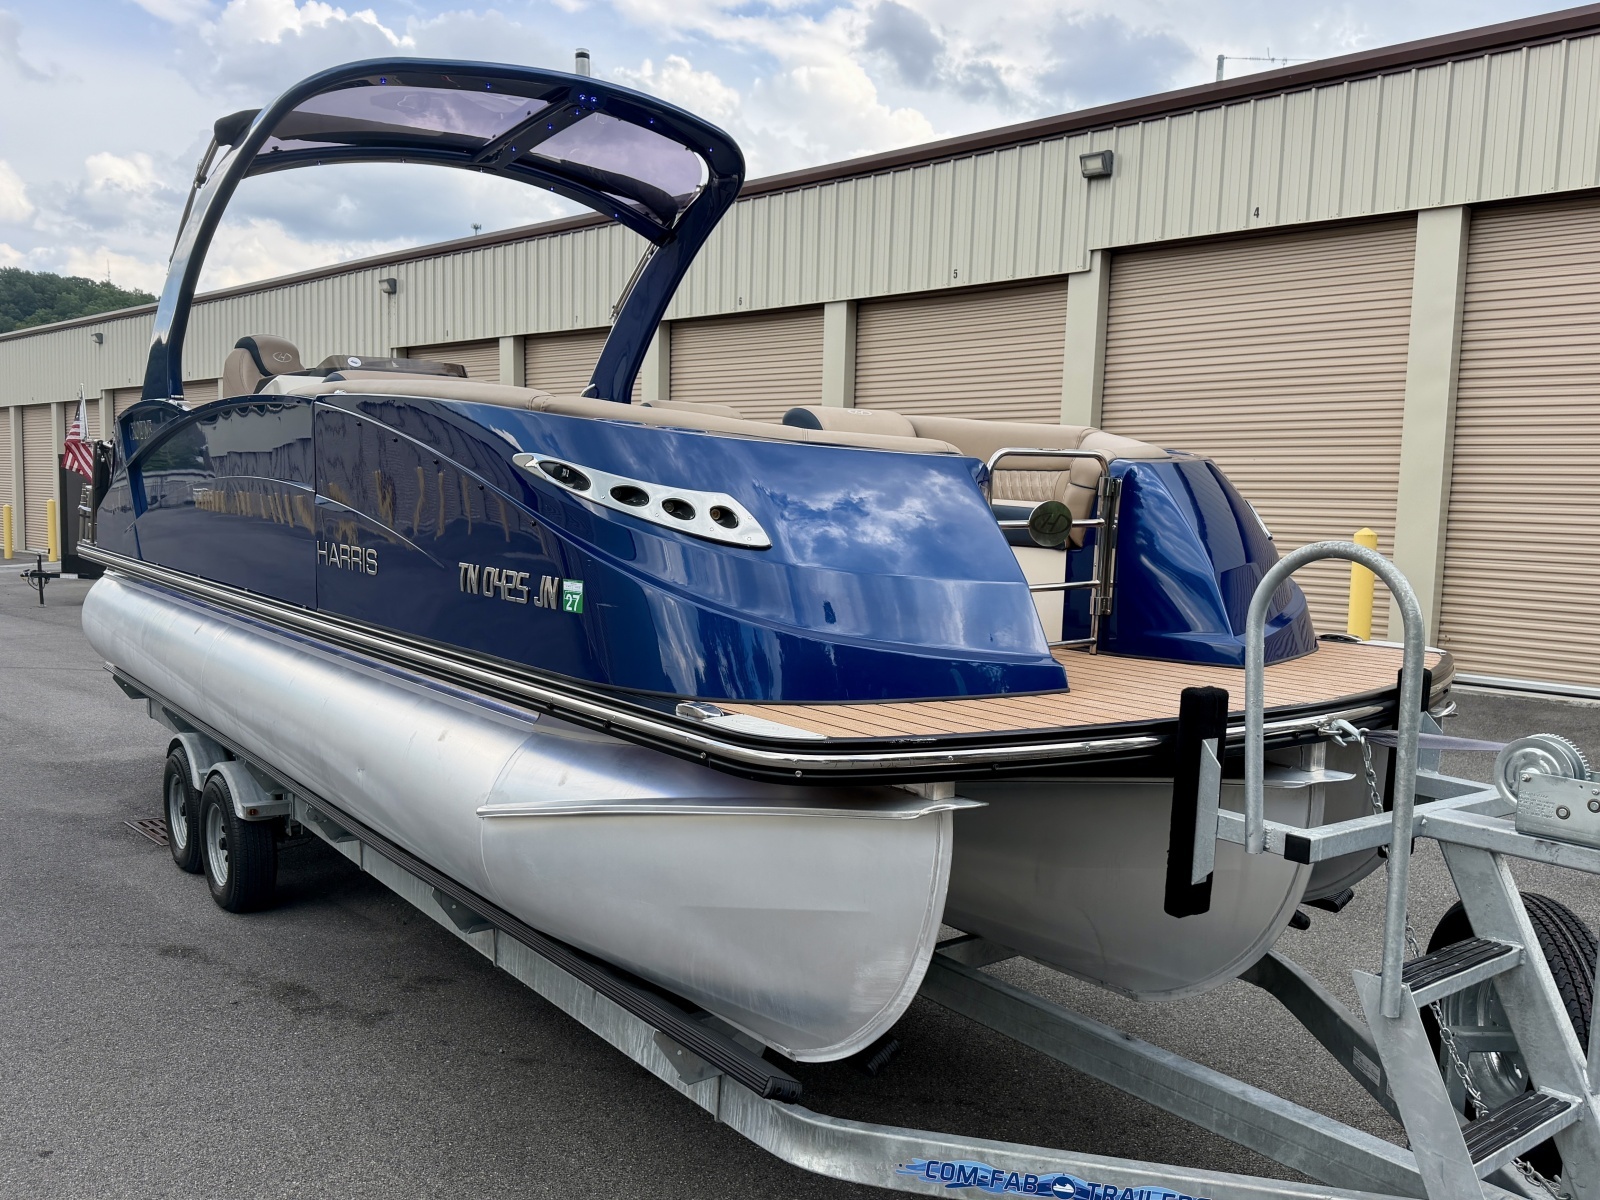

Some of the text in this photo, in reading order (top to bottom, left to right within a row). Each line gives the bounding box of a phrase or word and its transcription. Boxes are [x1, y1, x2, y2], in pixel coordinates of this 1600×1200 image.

[1253, 206, 1260, 219] 4
[953, 268, 958, 279] 5
[738, 296, 743, 306] 6
[316, 540, 378, 576] HARRIS
[458, 562, 560, 610] TN 0425 JN
[565, 593, 581, 612] 27
[924, 1160, 1212, 1200] COM-FAB TRAIL
